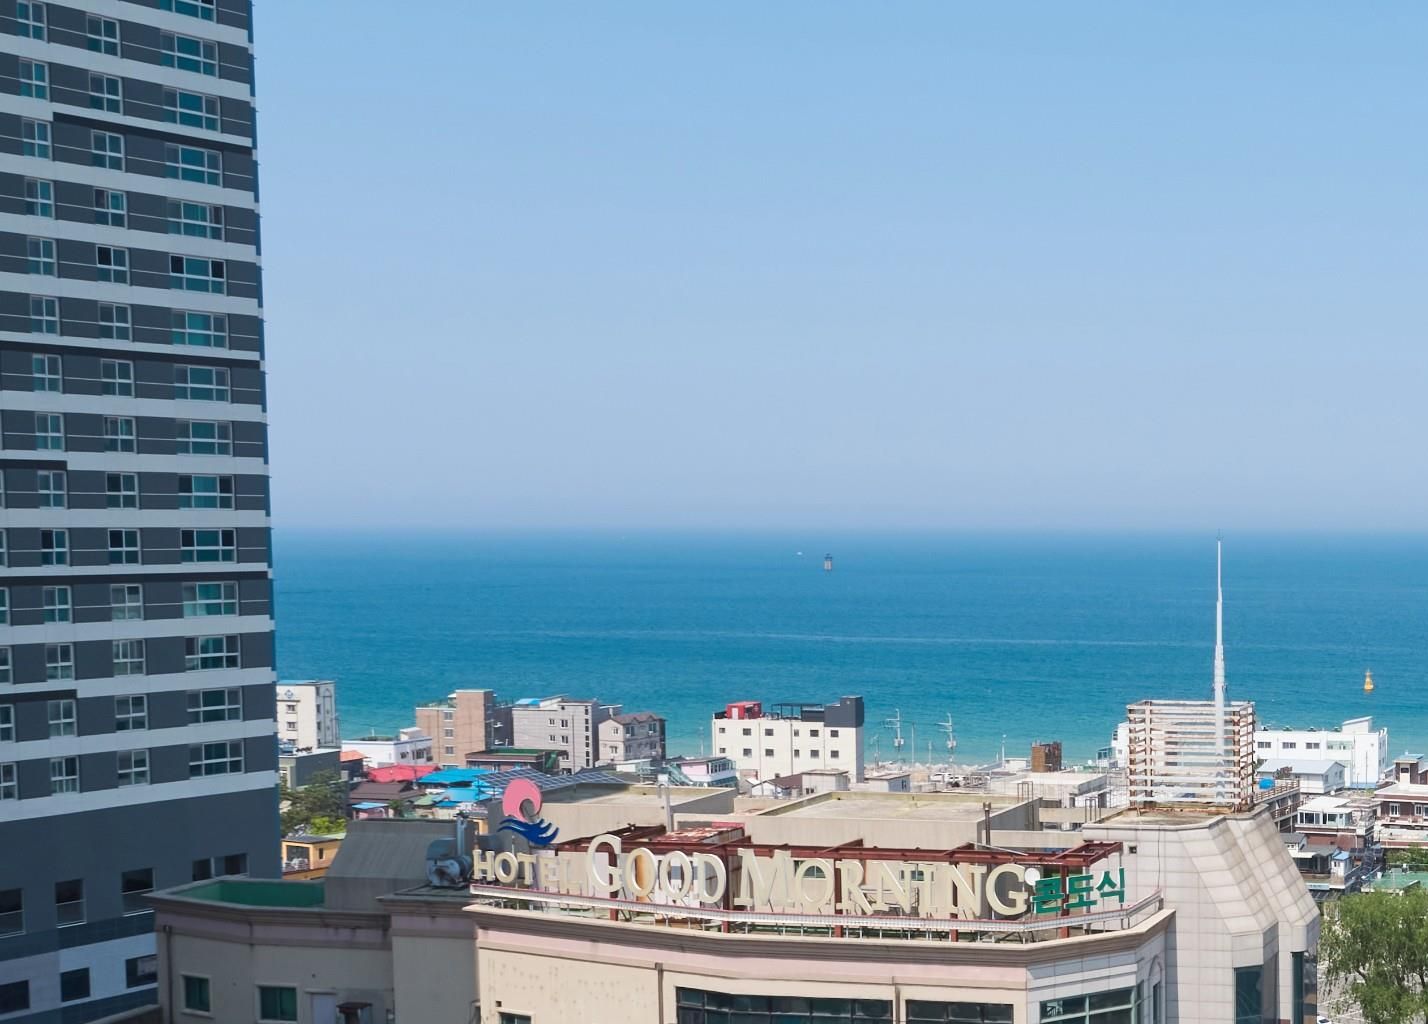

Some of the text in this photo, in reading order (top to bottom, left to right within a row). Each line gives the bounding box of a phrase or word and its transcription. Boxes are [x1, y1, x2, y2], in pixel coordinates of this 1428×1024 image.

[472, 833, 1029, 916] HOTEL GOOD MORNING
[1029, 867, 1127, 915] 콘도식
